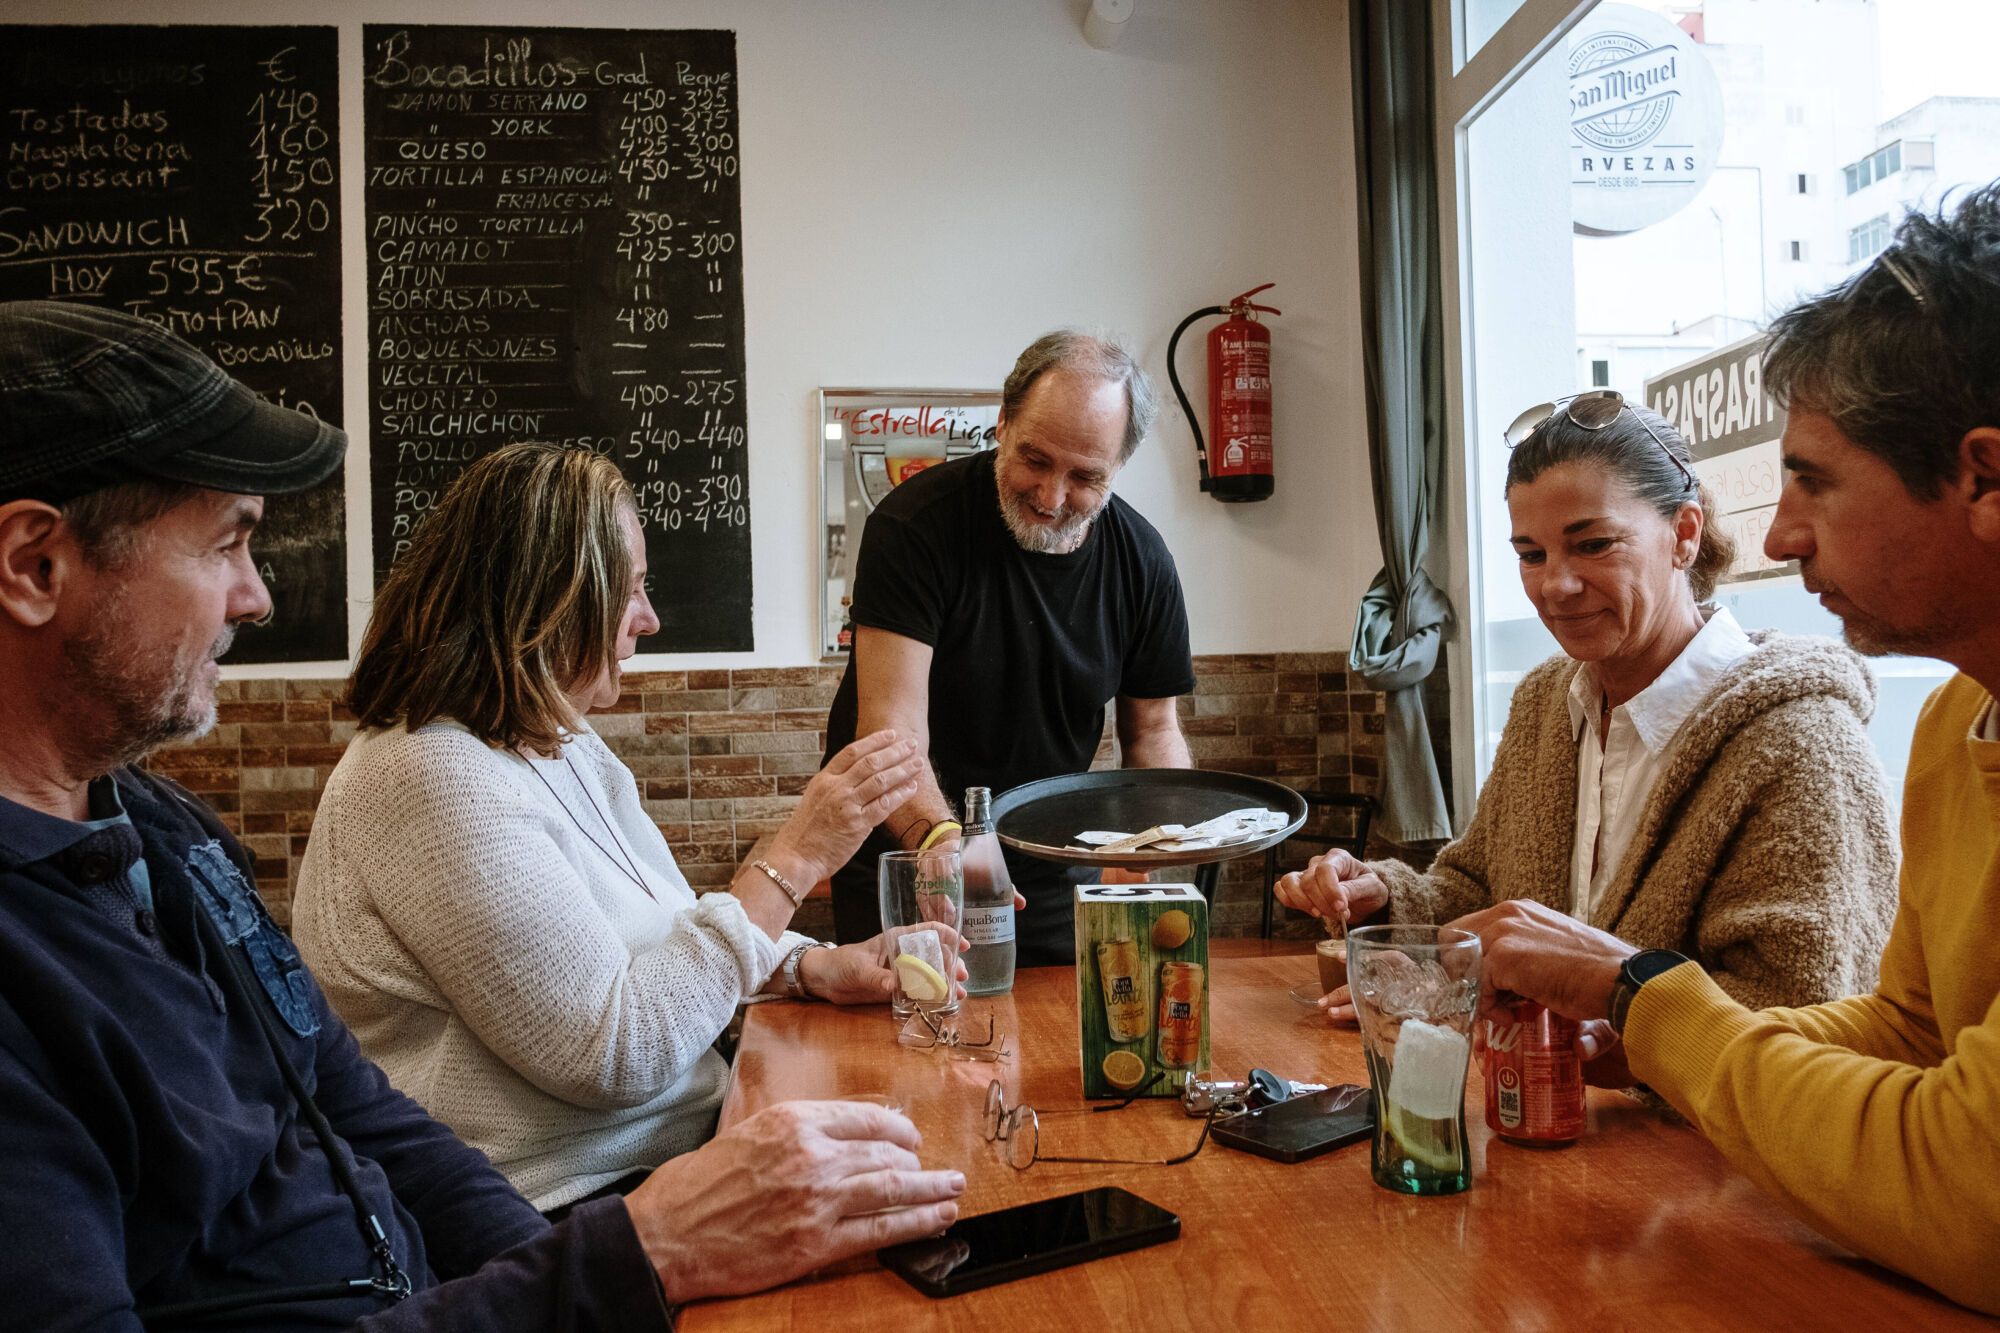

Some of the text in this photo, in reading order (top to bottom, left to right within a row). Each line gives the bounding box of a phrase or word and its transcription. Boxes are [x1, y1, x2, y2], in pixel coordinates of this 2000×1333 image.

[257, 46, 297, 82] €
[9, 88, 319, 133] Tostadas 1'40
[487, 92, 588, 111] SERRANO
[490, 118, 553, 136] YORK
[249, 121, 328, 158] 1'60
[398, 141, 487, 160] QUESO
[1582, 156, 1695, 172] RVEZAS
[8, 157, 334, 197] Croissant 1'50
[369, 166, 485, 186] TORTILLA
[0, 198, 330, 257] SANDWICH 3'20
[373, 215, 458, 237] PINCHO
[478, 217, 584, 234] TORTILLA
[50, 262, 113, 296] HOY
[377, 265, 446, 288] ATUN
[375, 288, 540, 311] SOBRASADA
[378, 306, 669, 335] ANCHOAS 4'80
[378, 338, 557, 359] BOQUERONES
[381, 364, 490, 386] VEGETAL
[379, 387, 498, 411] CHORIZO
[380, 412, 544, 437] SALCHICHON
[849, 404, 947, 437] Estrella
[398, 440, 477, 463] POLLO
